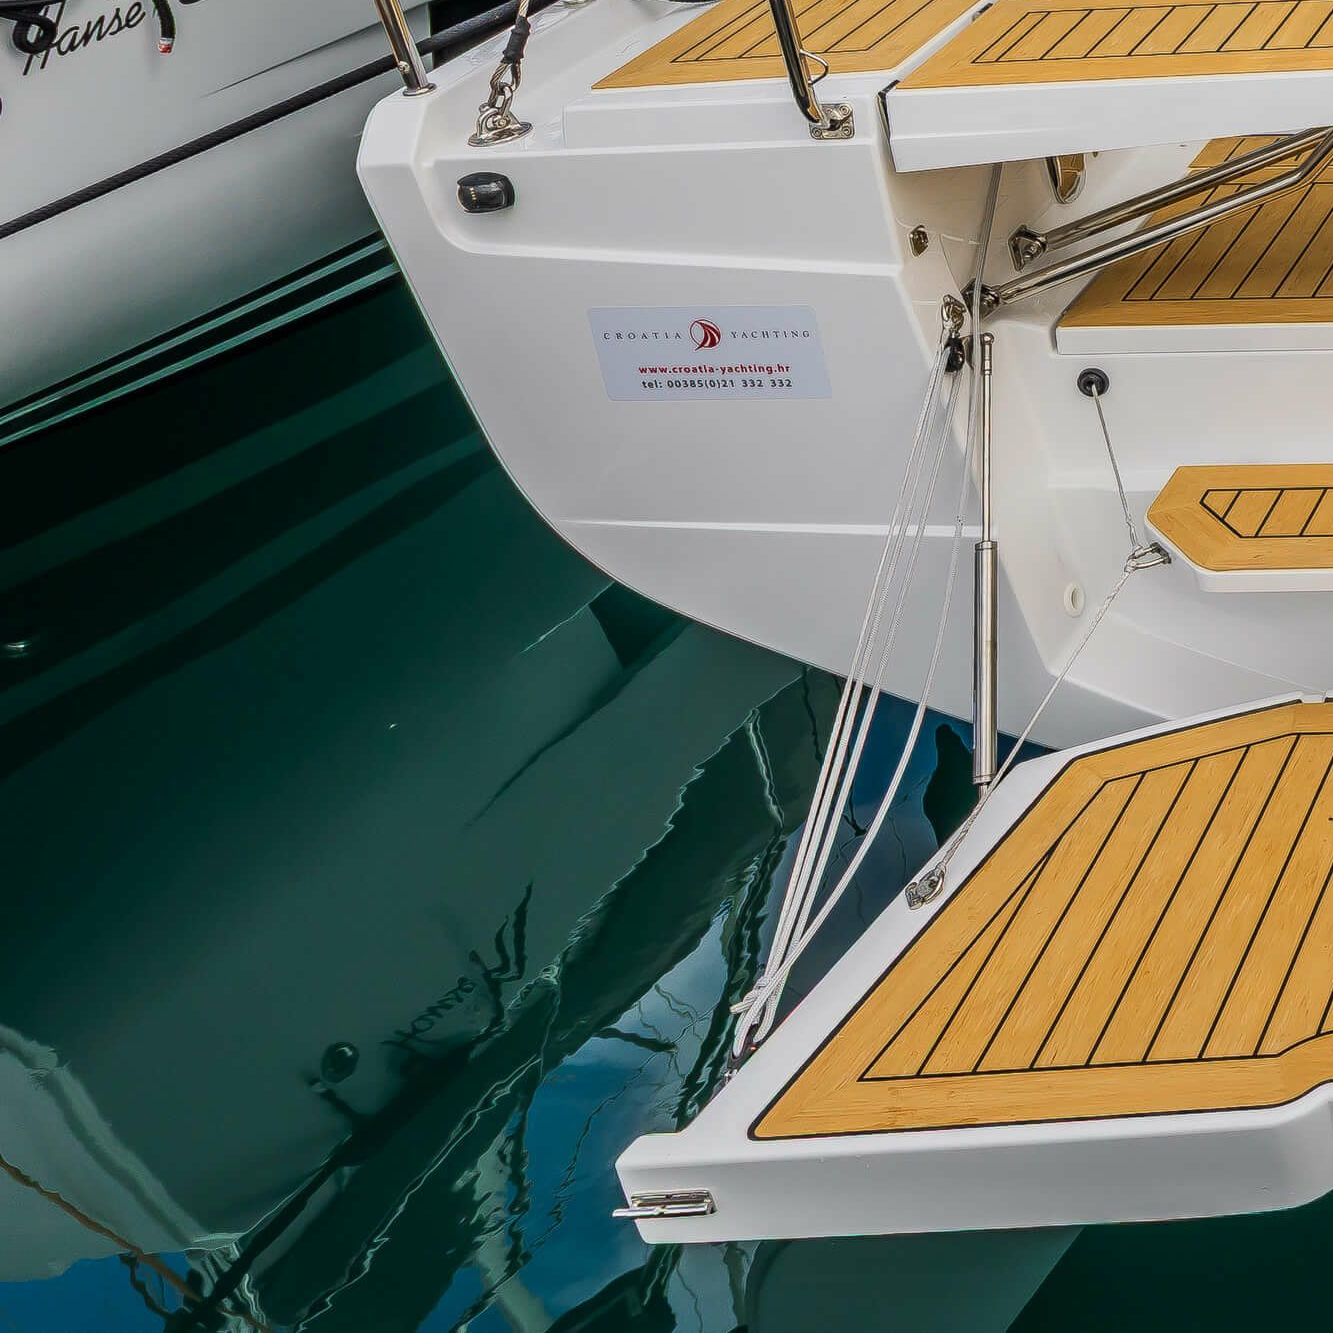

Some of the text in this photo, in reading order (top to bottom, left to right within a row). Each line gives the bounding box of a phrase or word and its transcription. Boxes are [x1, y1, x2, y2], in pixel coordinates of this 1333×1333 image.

[603, 329, 811, 341] CROATIA YACHTING
[638, 364, 791, 375] www.croatia-yachting.hr
[641, 378, 793, 389] tel: 00385(0)21 332 332
